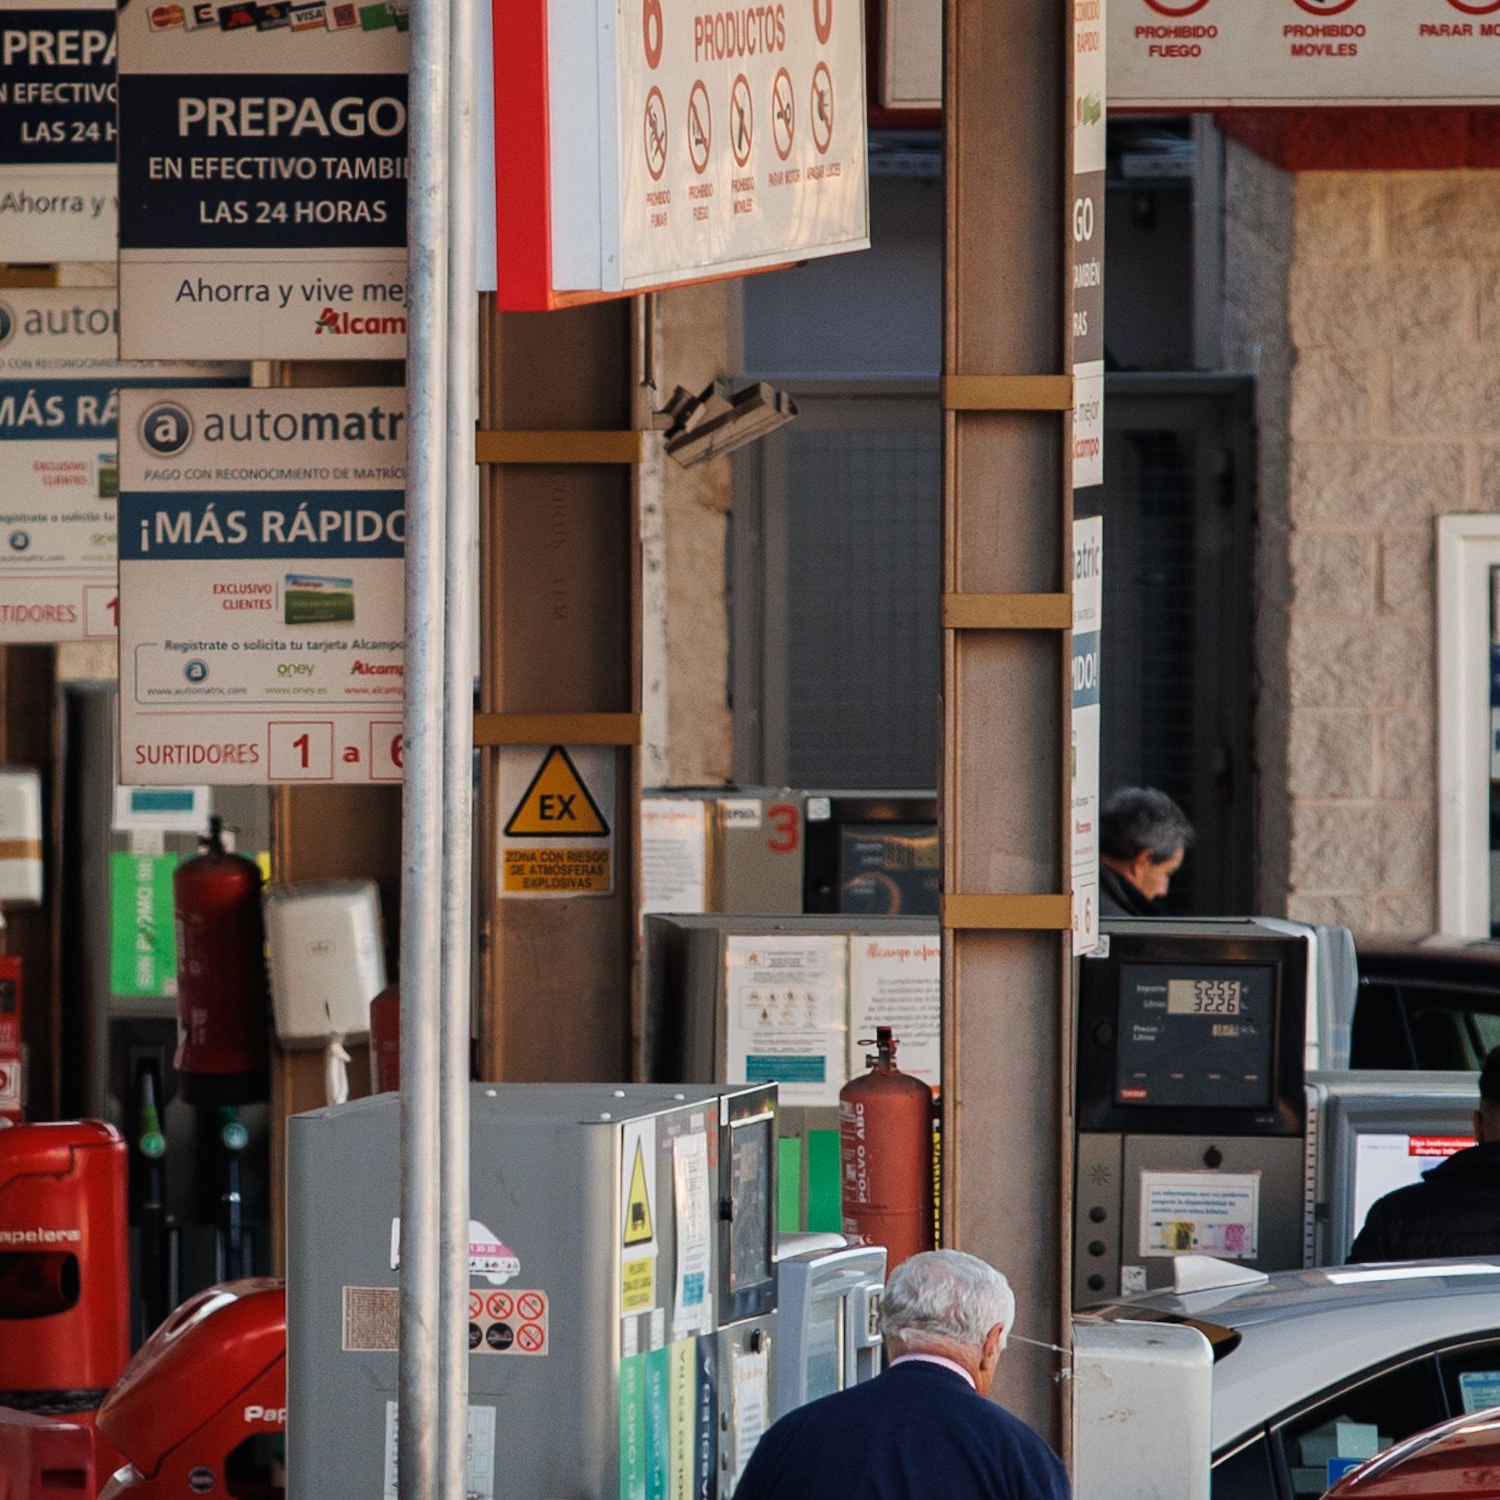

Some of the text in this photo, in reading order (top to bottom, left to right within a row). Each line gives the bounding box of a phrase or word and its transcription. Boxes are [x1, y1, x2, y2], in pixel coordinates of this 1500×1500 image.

[295, 10, 325, 22] VISA
[695, 3, 786, 62] PRODUCTOS
[1135, 24, 1218, 39] PROHIBIDO
[1283, 23, 1366, 39] PROHIBIDO
[1419, 23, 1473, 37] PARAR
[1148, 44, 1201, 58] FUEGO
[1291, 43, 1358, 57] MOVILES
[178, 97, 406, 137] PREPAGO
[21, 122, 64, 142] LAS
[70, 122, 100, 142] 24
[149, 156, 408, 180] EN EFECTIVO TAMBI
[0, 191, 105, 217] Ahorra y
[200, 200, 387, 224] LAS 24 HORAS
[176, 278, 269, 303] Ahorra
[278, 284, 293, 306] y
[302, 277, 353, 302] vive
[144, 468, 180, 481] PAGO
[185, 467, 211, 481] CON
[216, 466, 329, 481] RECONOCIMIENTO
[333, 467, 349, 480] DE
[141, 503, 247, 551] ¡MÁS
[1073, 534, 1100, 581] atric
[213, 583, 272, 595] EXCLUSIVO
[223, 599, 272, 610] CLIENTES
[232, 642, 239, 650] o
[290, 641, 303, 651] tu
[135, 743, 259, 765] SURTIDORES
[292, 733, 310, 769] 1
[342, 744, 360, 764] a
[540, 795, 576, 820] EX
[767, 803, 800, 855] 3
[506, 850, 609, 862] ZONA CON RIESGO
[523, 877, 592, 888] EXPLOSIVAS
[1194, 980, 1237, 998] 52.55
[856, 1103, 865, 1140] ABC
[857, 1145, 867, 1203] POLVO
